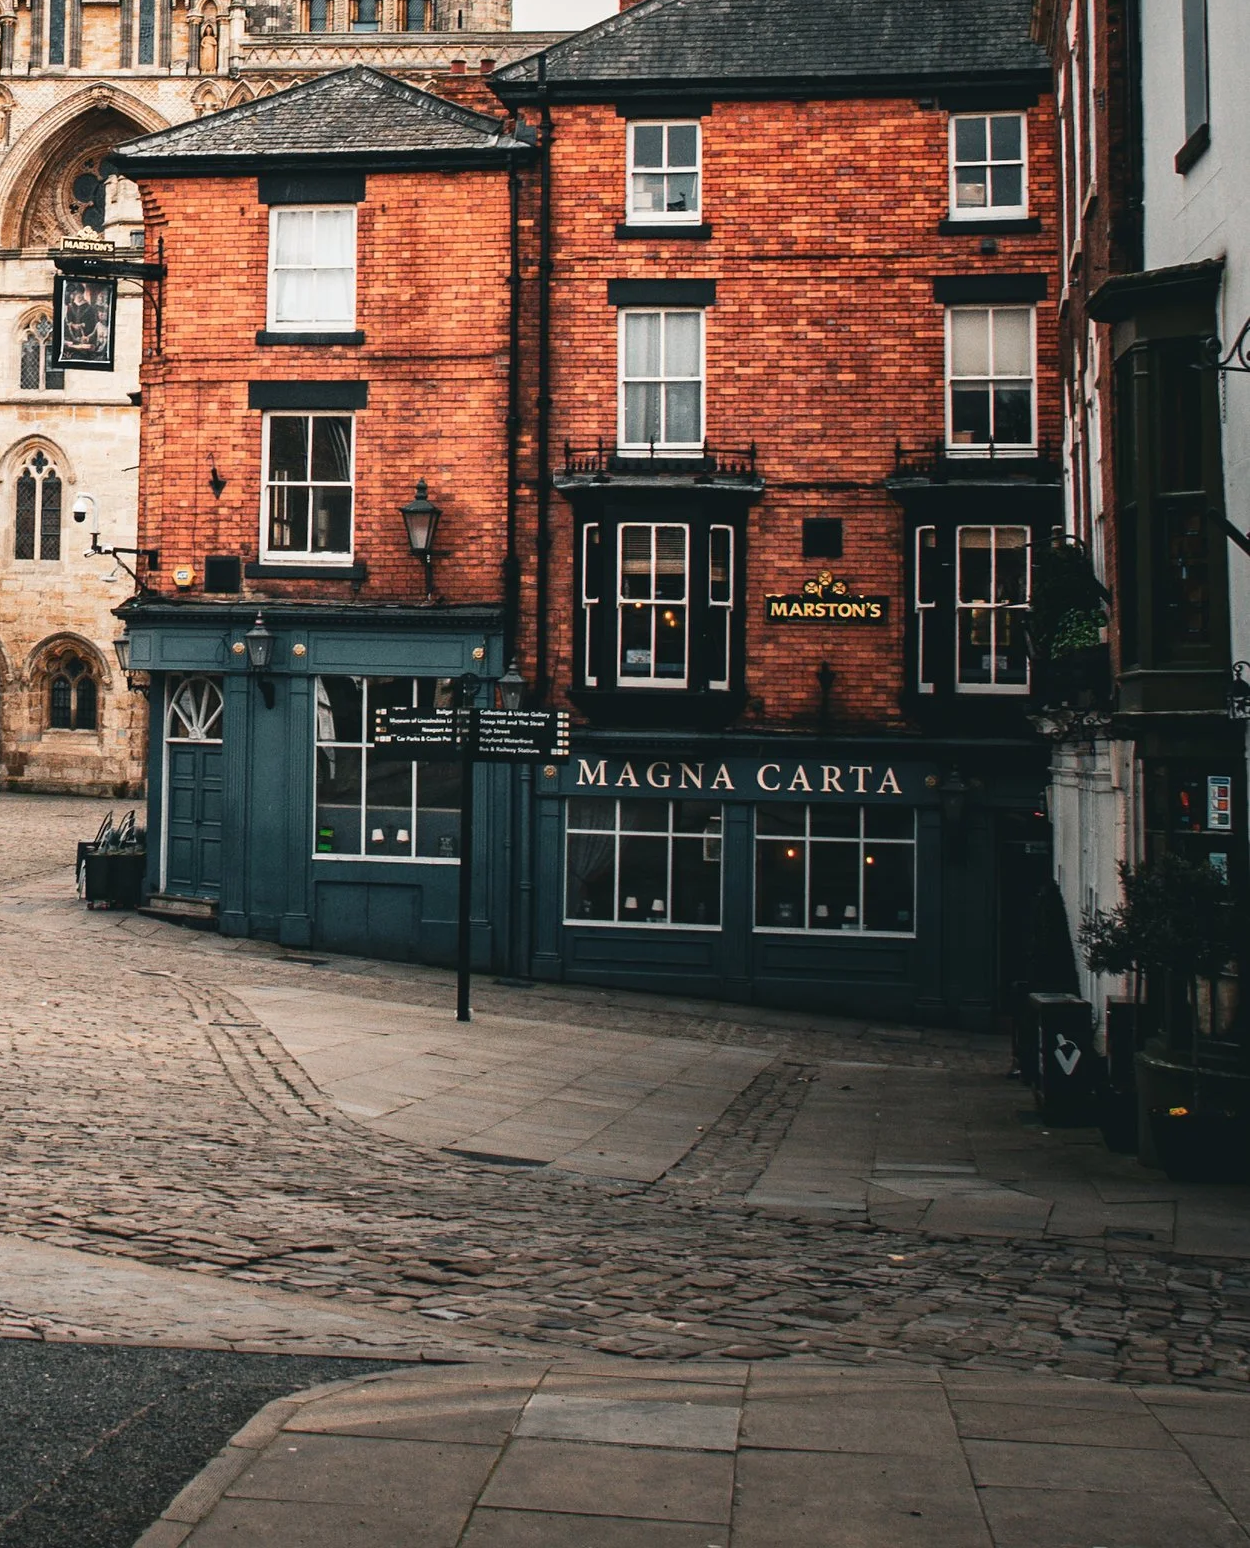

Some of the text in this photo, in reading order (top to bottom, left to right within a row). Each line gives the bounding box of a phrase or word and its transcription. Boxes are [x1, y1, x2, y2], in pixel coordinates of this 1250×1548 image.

[64, 240, 114, 252] MARSTON'S
[770, 602, 882, 618] MARSTON'S
[576, 758, 903, 794] MAGNA CARTA
